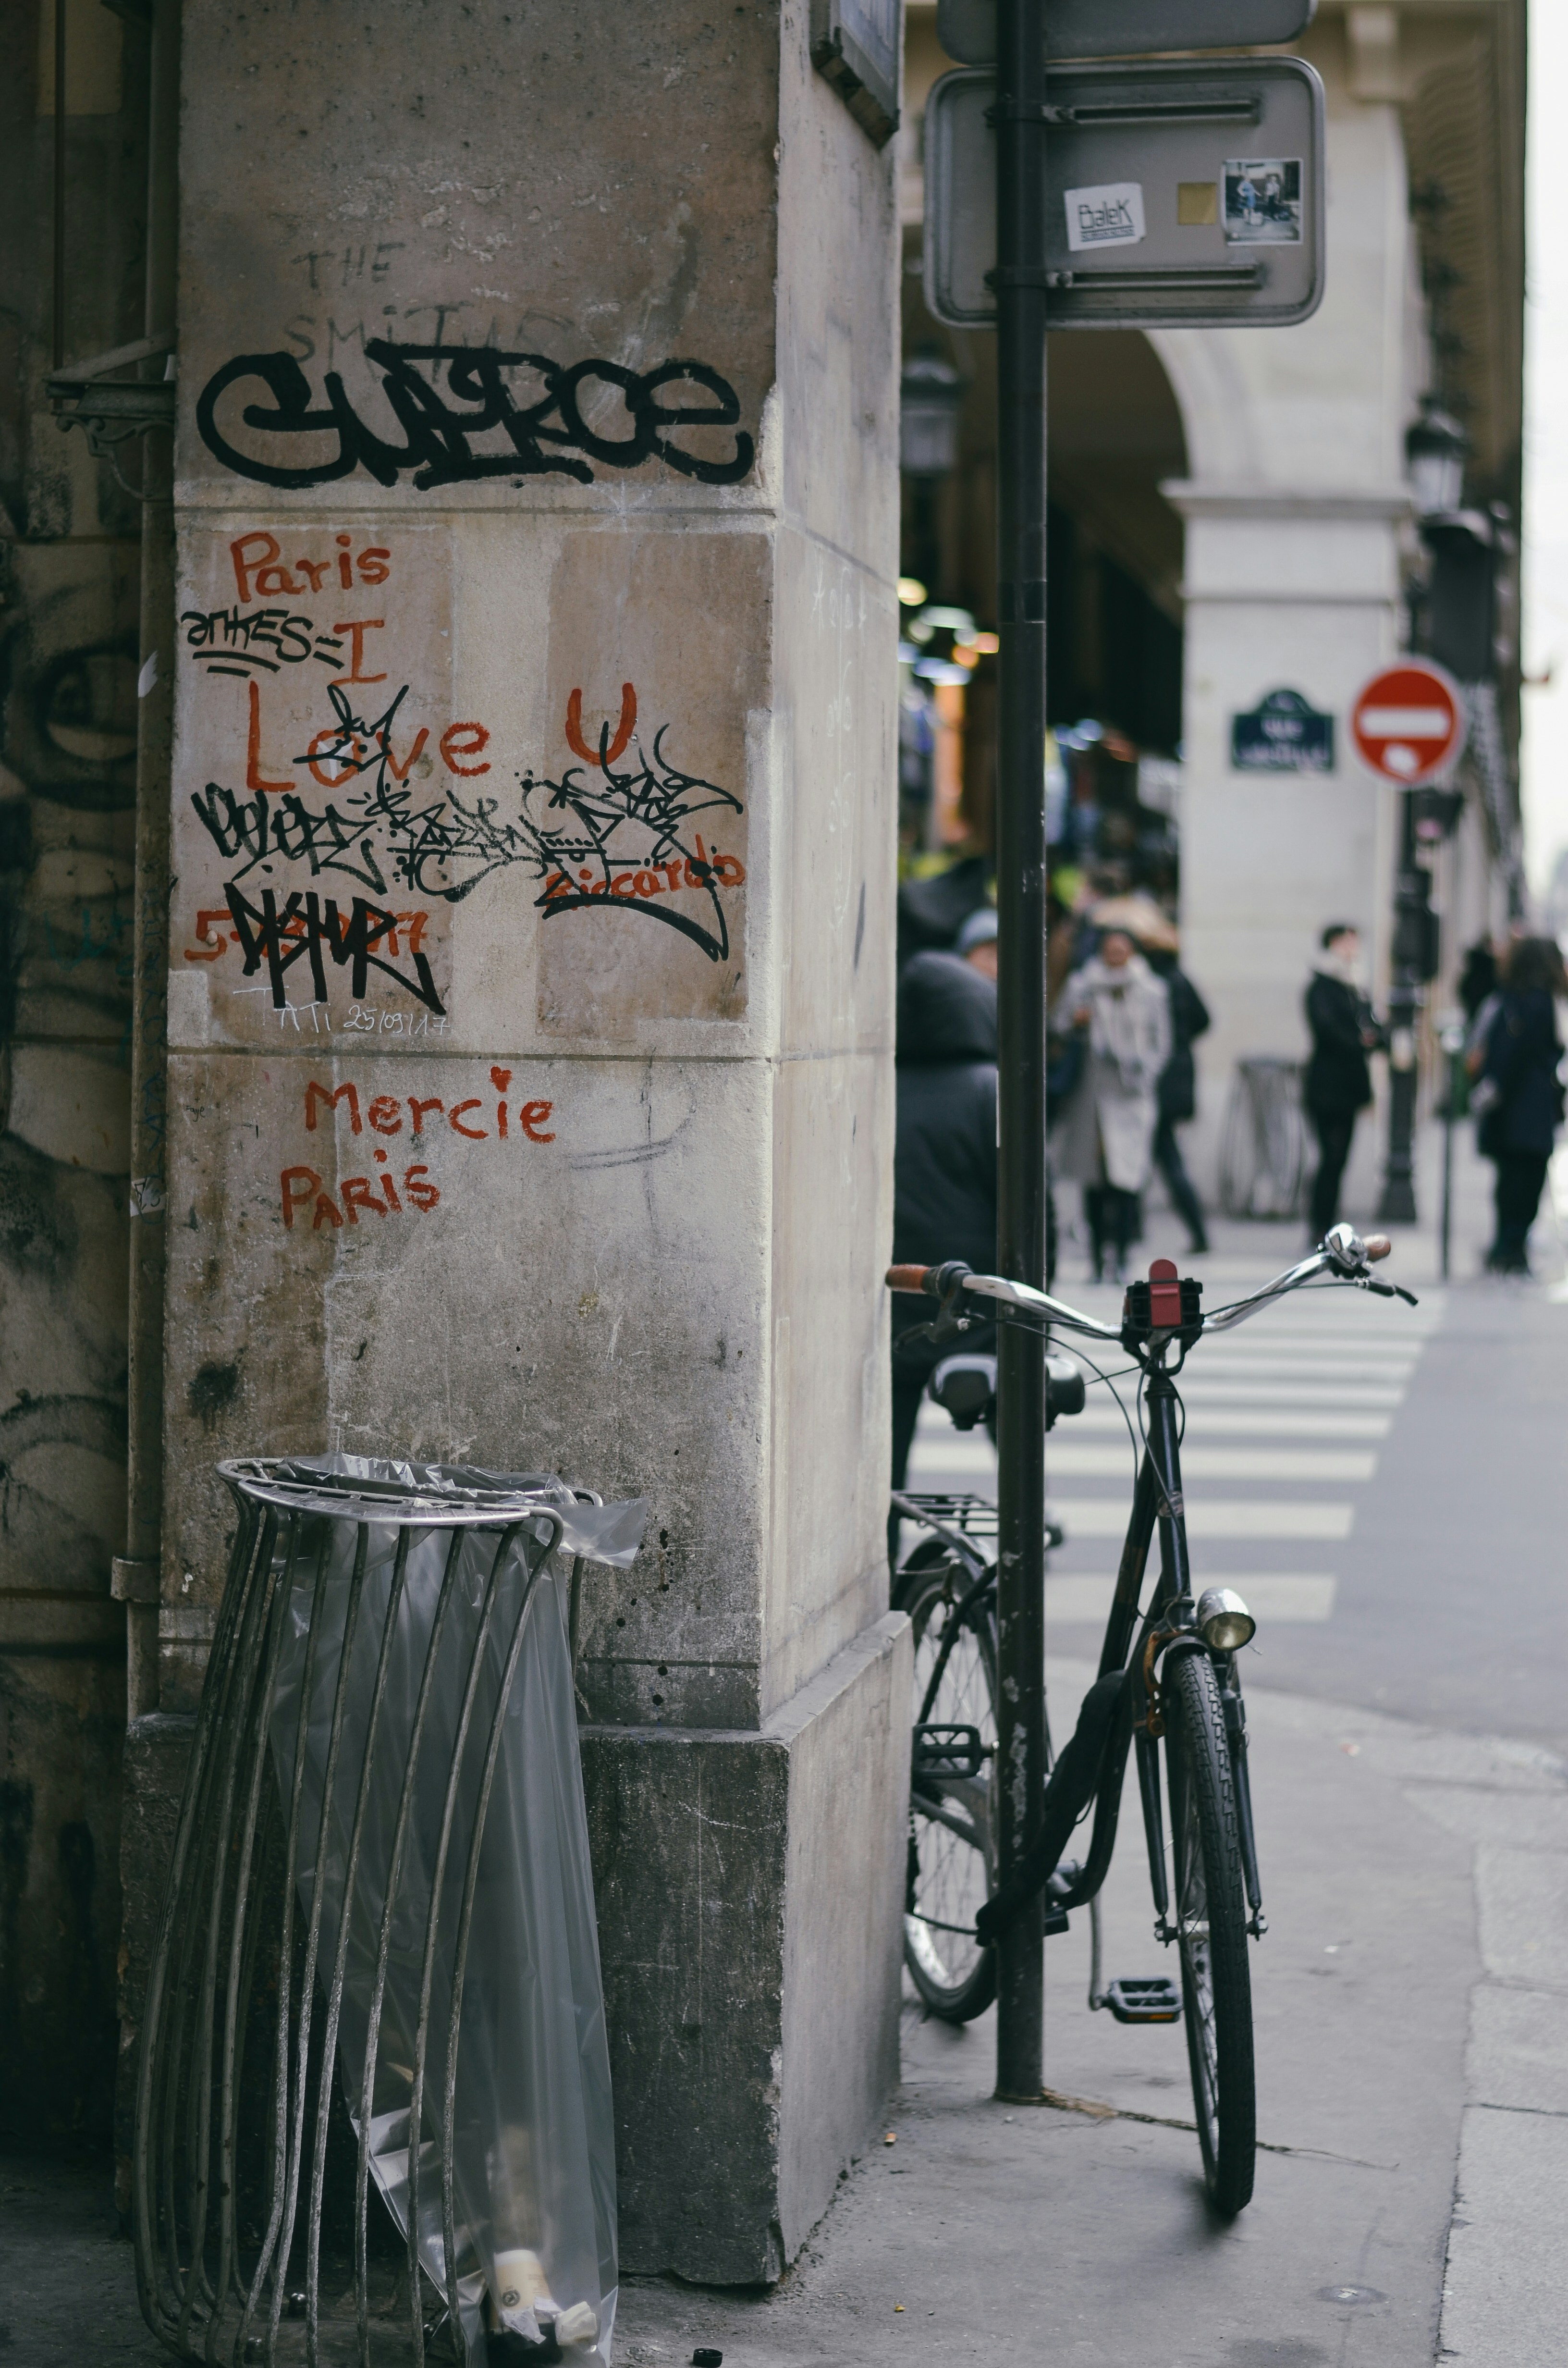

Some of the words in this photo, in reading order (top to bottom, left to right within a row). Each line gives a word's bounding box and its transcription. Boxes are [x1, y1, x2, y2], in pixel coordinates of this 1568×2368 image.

[290, 242, 406, 291] THE
[230, 532, 391, 603] Paris
[330, 620, 387, 686] I
[247, 680, 490, 792] Love
[566, 683, 637, 765] U
[305, 1066, 556, 1144] Mercie
